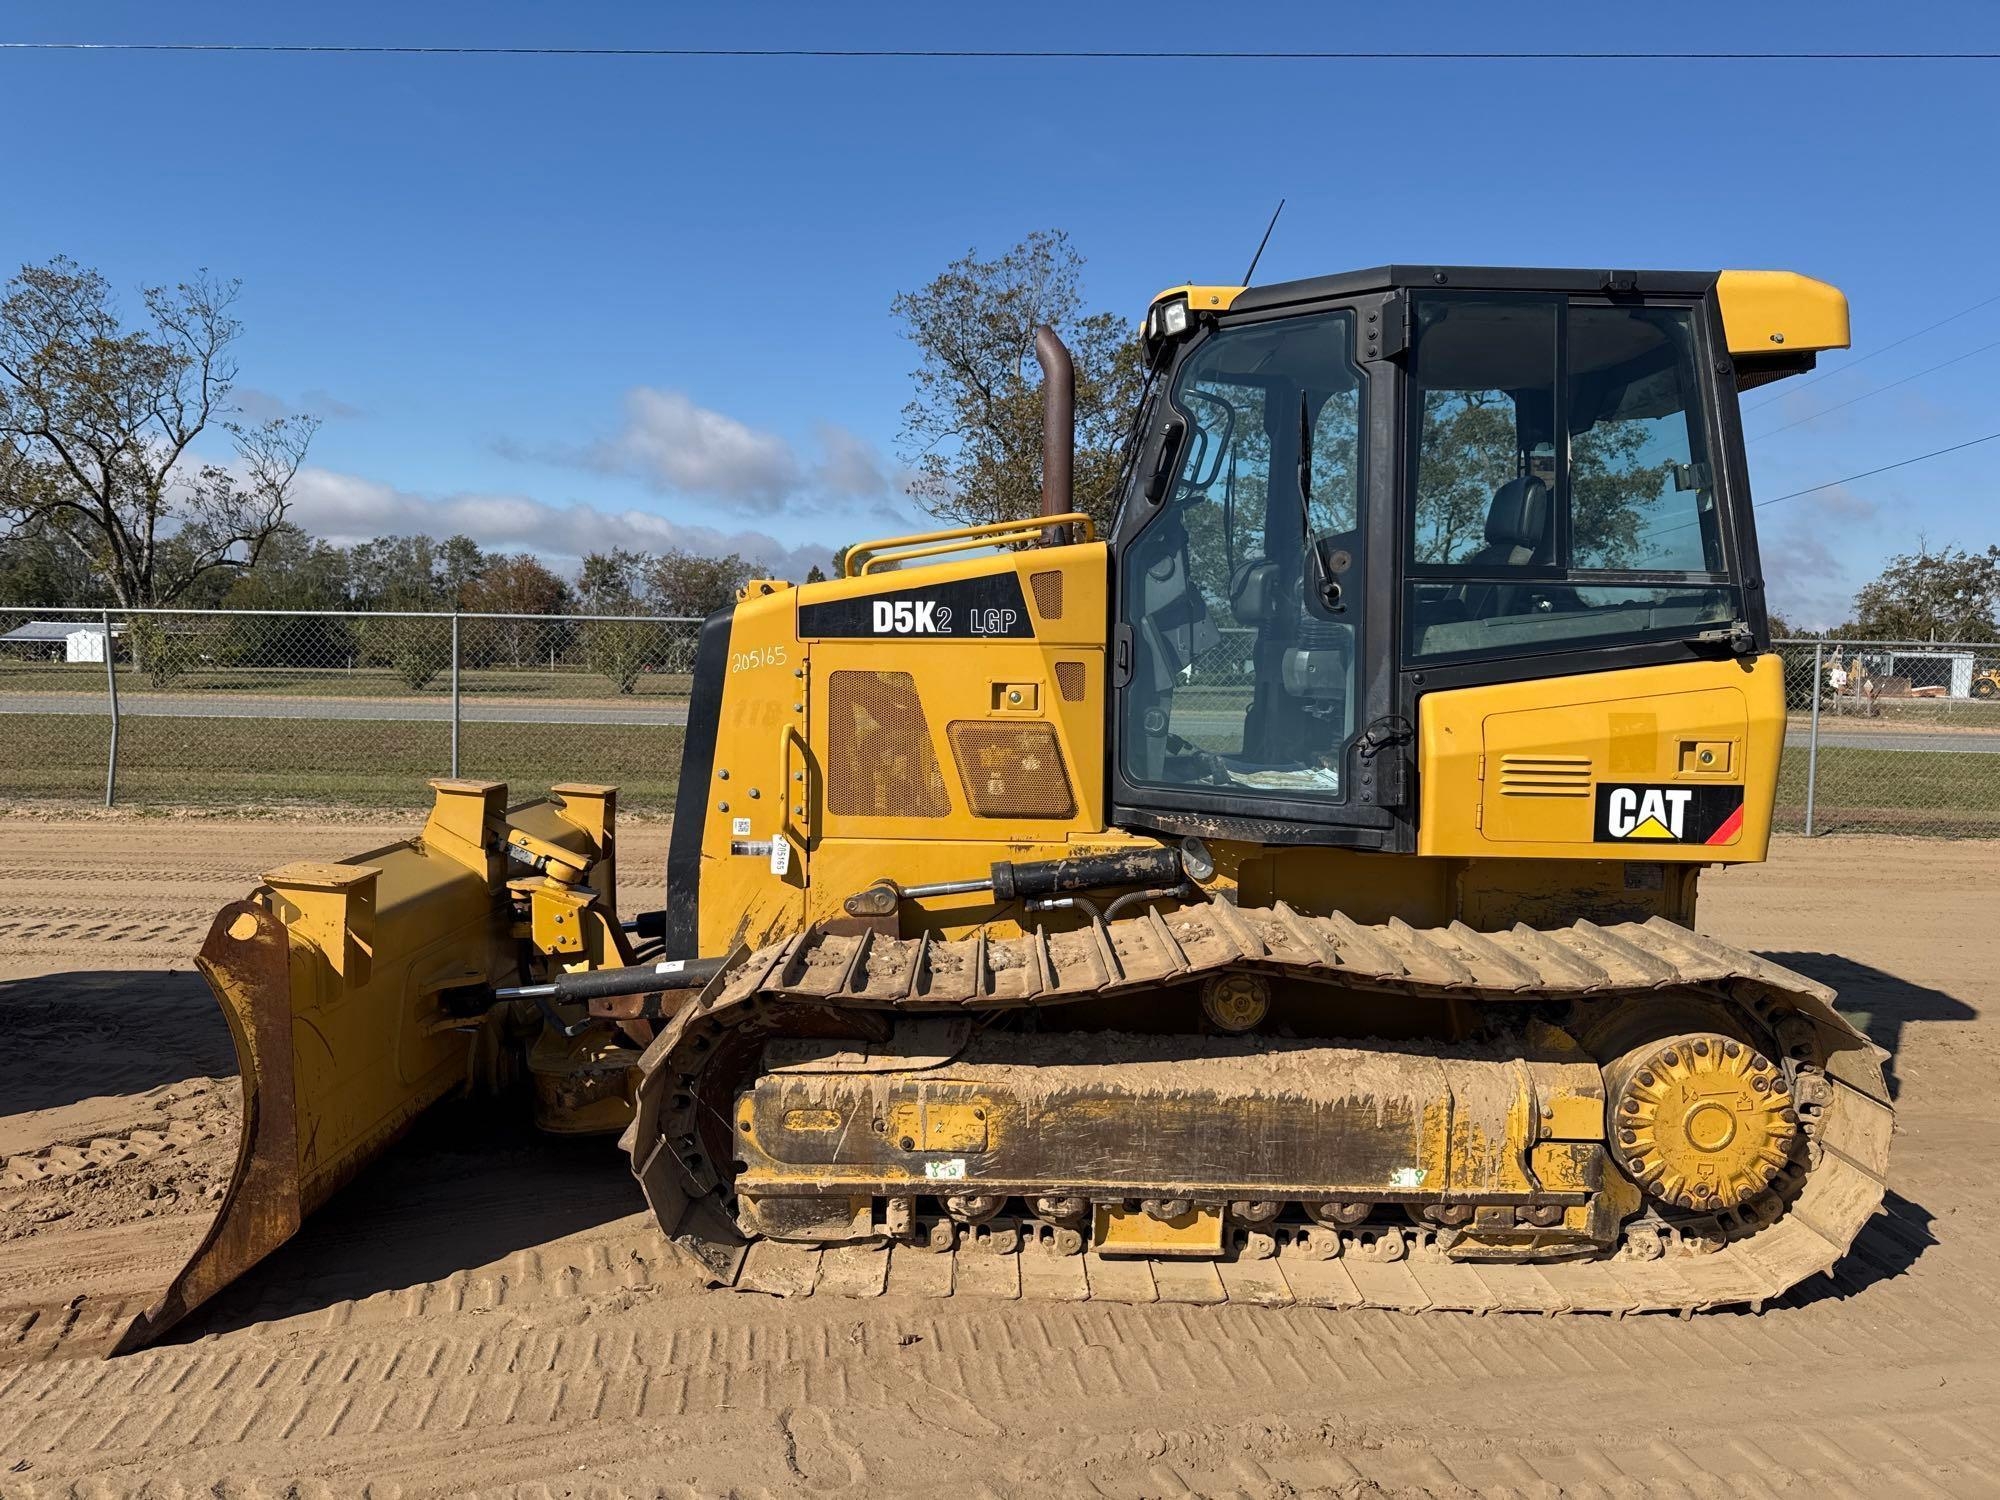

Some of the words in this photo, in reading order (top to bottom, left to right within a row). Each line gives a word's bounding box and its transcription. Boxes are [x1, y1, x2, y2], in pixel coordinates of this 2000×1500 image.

[873, 601, 952, 633] D5K2
[970, 609, 1017, 633] LGP
[732, 646, 787, 673] 205165
[1608, 788, 1692, 838] CAT
[776, 843, 787, 870] 205165
